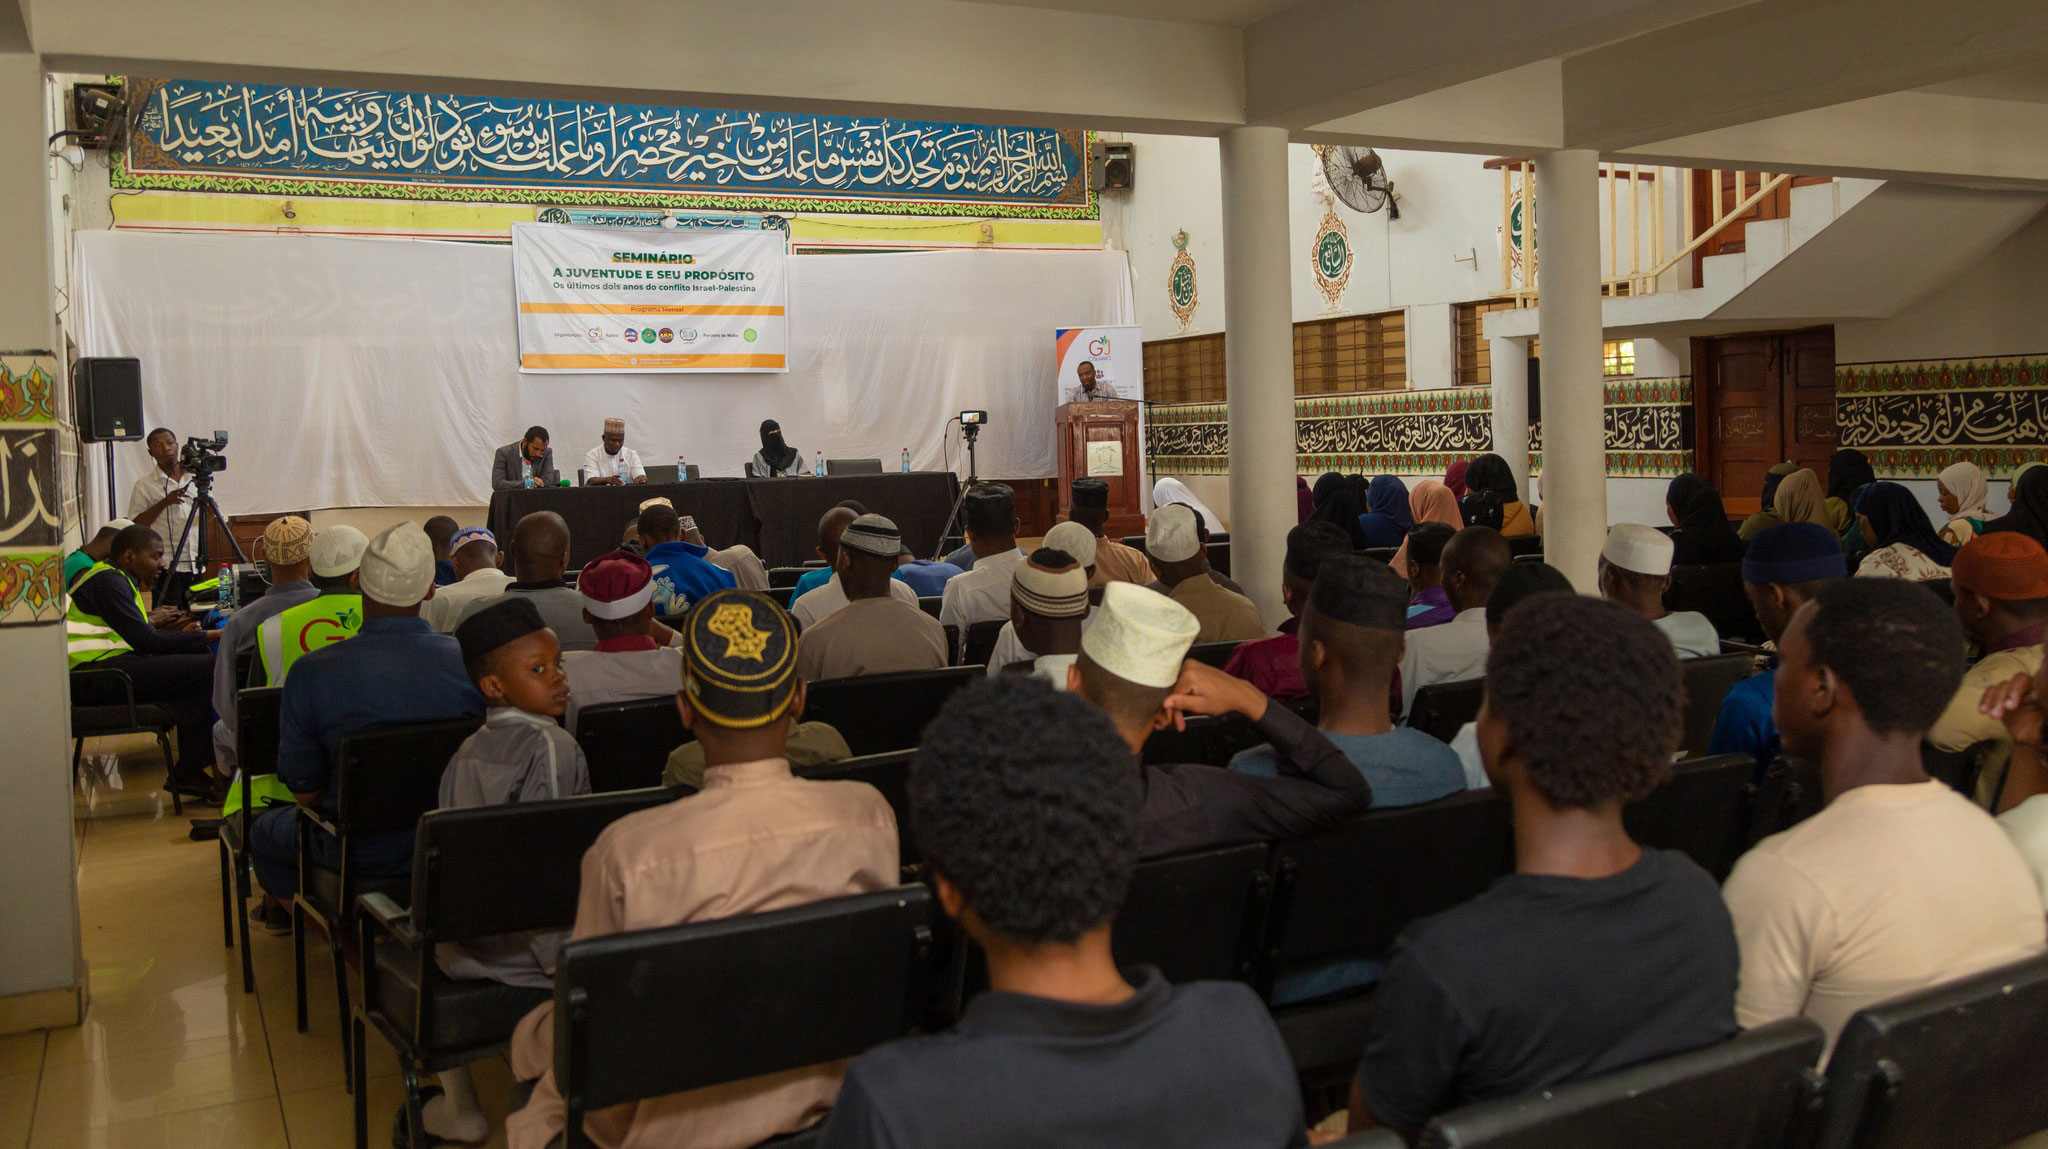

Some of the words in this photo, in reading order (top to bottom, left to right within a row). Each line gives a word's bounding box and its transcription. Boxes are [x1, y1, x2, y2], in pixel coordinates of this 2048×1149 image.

[613, 251, 693, 264] SEMINÁRIO
[553, 267, 563, 277] A
[566, 268, 642, 279] JUVENTUDE
[646, 270, 654, 279] E
[657, 270, 681, 279] SEU
[684, 269, 755, 281] PROPÓSITO
[553, 281, 564, 289] Os
[566, 281, 600, 290] últimos
[602, 282, 620, 290] dois
[645, 283, 657, 291] do
[658, 283, 690, 291] conflito
[692, 284, 756, 292] Israel-Palestina
[1089, 339, 1111, 356] GJ
